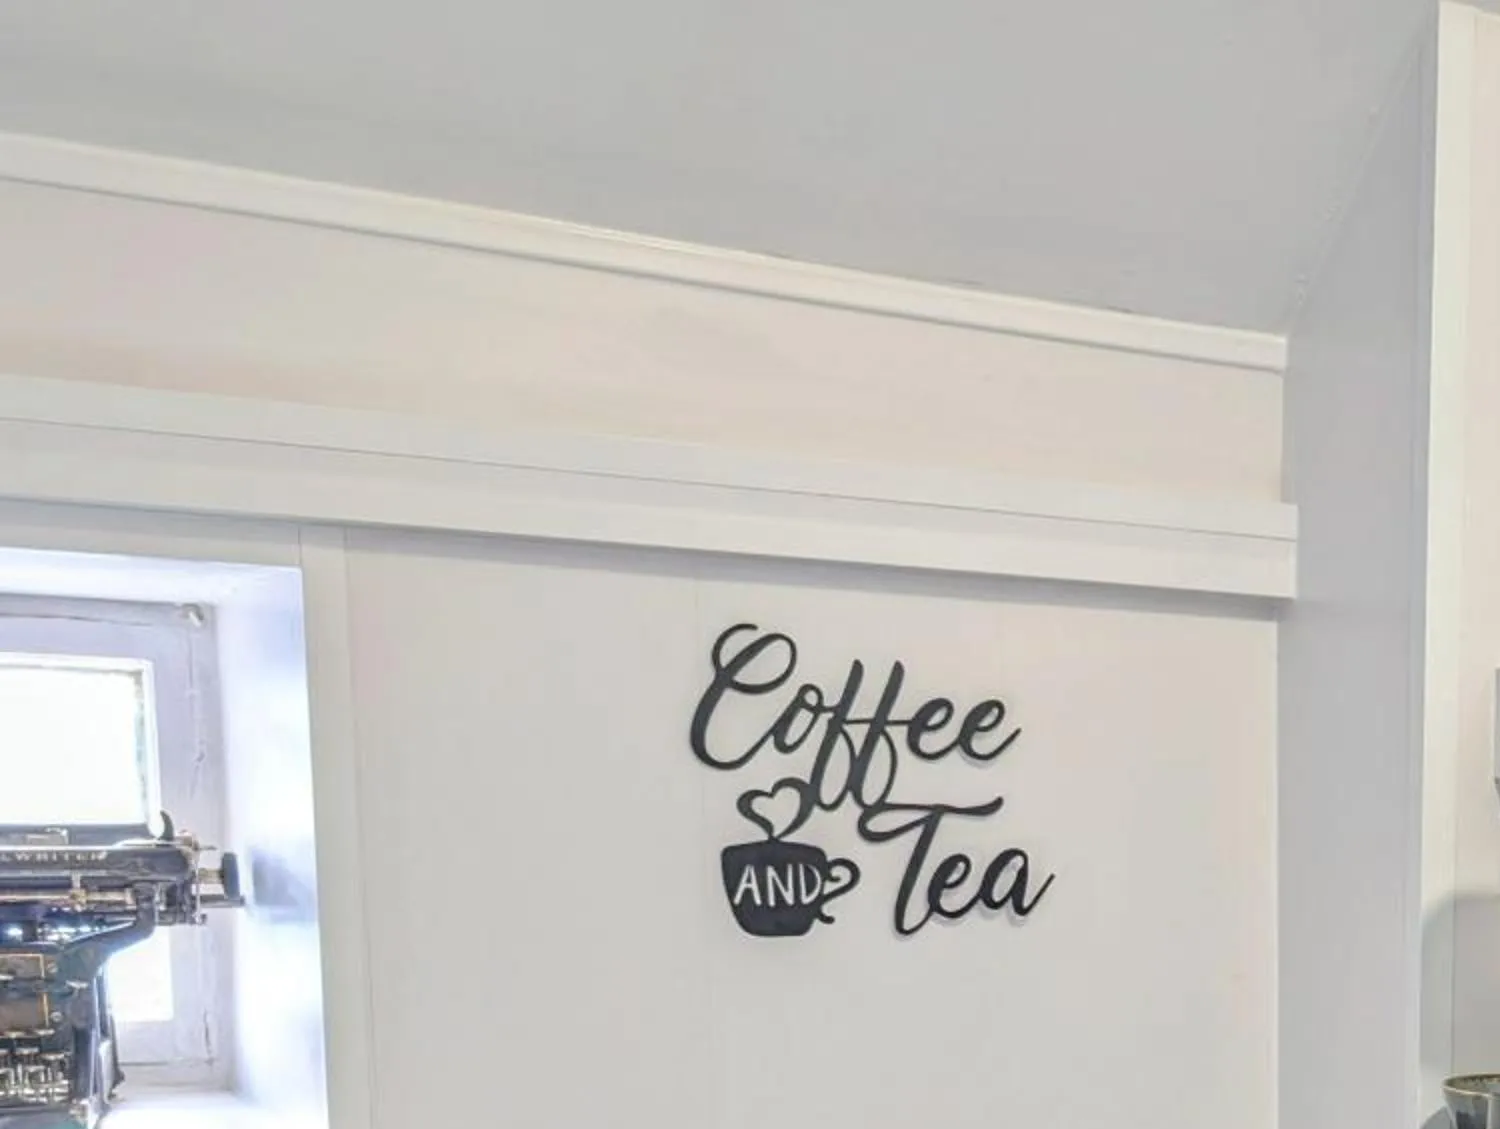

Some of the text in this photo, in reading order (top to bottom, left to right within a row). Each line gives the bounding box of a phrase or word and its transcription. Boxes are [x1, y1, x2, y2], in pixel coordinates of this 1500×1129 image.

[690, 623, 1022, 811] Coffee
[733, 796, 1056, 935] AND Tea
